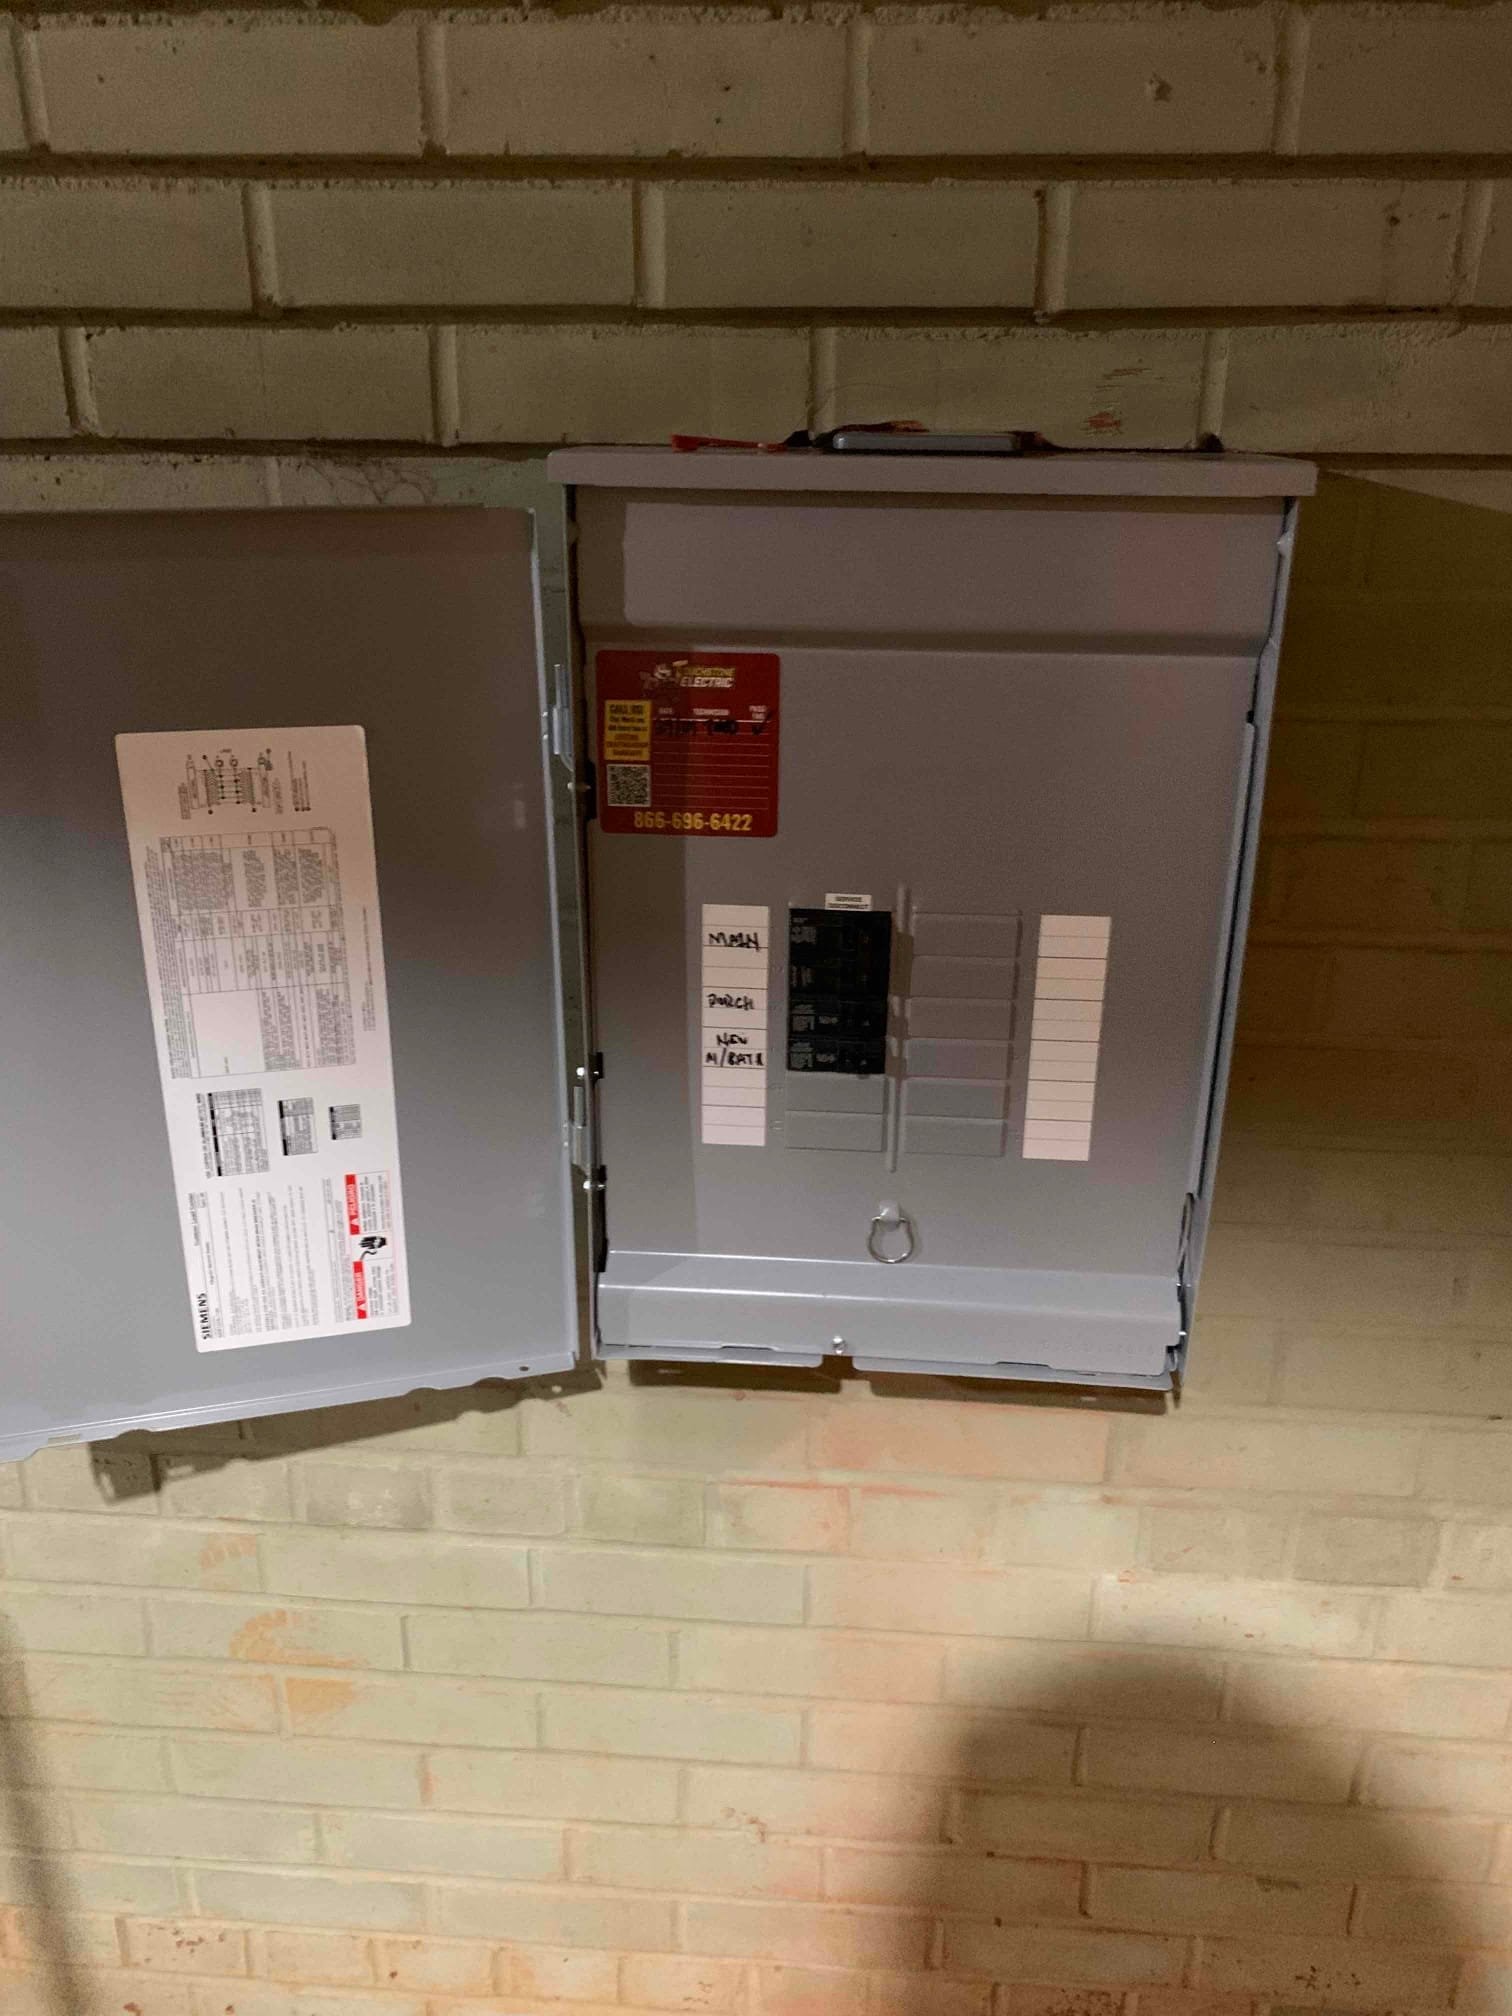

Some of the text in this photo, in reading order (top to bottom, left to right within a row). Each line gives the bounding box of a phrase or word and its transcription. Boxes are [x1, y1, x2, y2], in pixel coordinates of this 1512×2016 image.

[680, 676, 735, 688] ELECTRIC
[634, 810, 753, 832] 866-696-6422
[197, 1292, 212, 1340] SIEMENS
